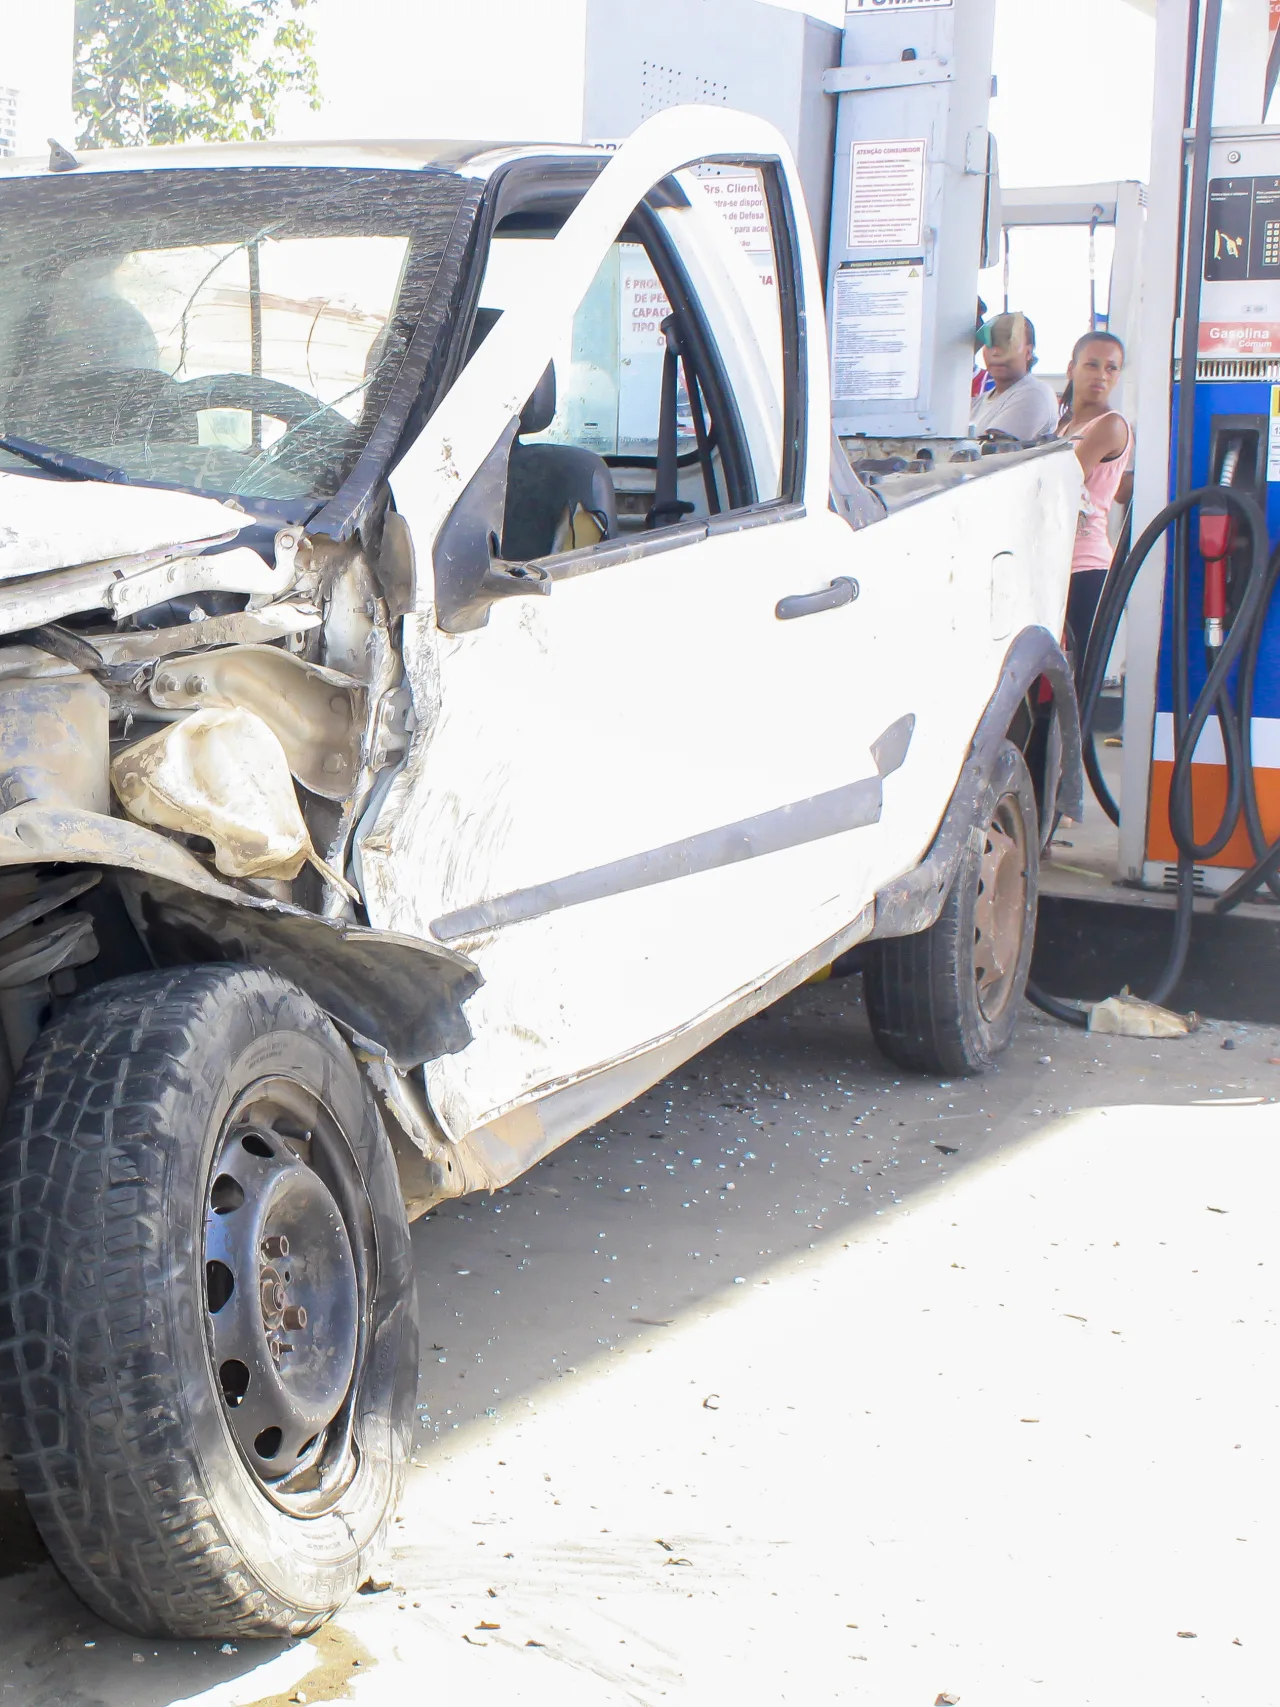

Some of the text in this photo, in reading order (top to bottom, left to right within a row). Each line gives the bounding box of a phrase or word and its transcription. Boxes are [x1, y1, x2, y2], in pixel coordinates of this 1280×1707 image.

[856, 146, 921, 155] ATENÇÃO CONSUMIDOR
[739, 211, 764, 220] Defesa
[734, 226, 750, 235] para
[634, 293, 648, 304] DE
[632, 322, 656, 332] TIPO
[1209, 327, 1270, 340] Gasolina
[1238, 339, 1272, 348] Comum
